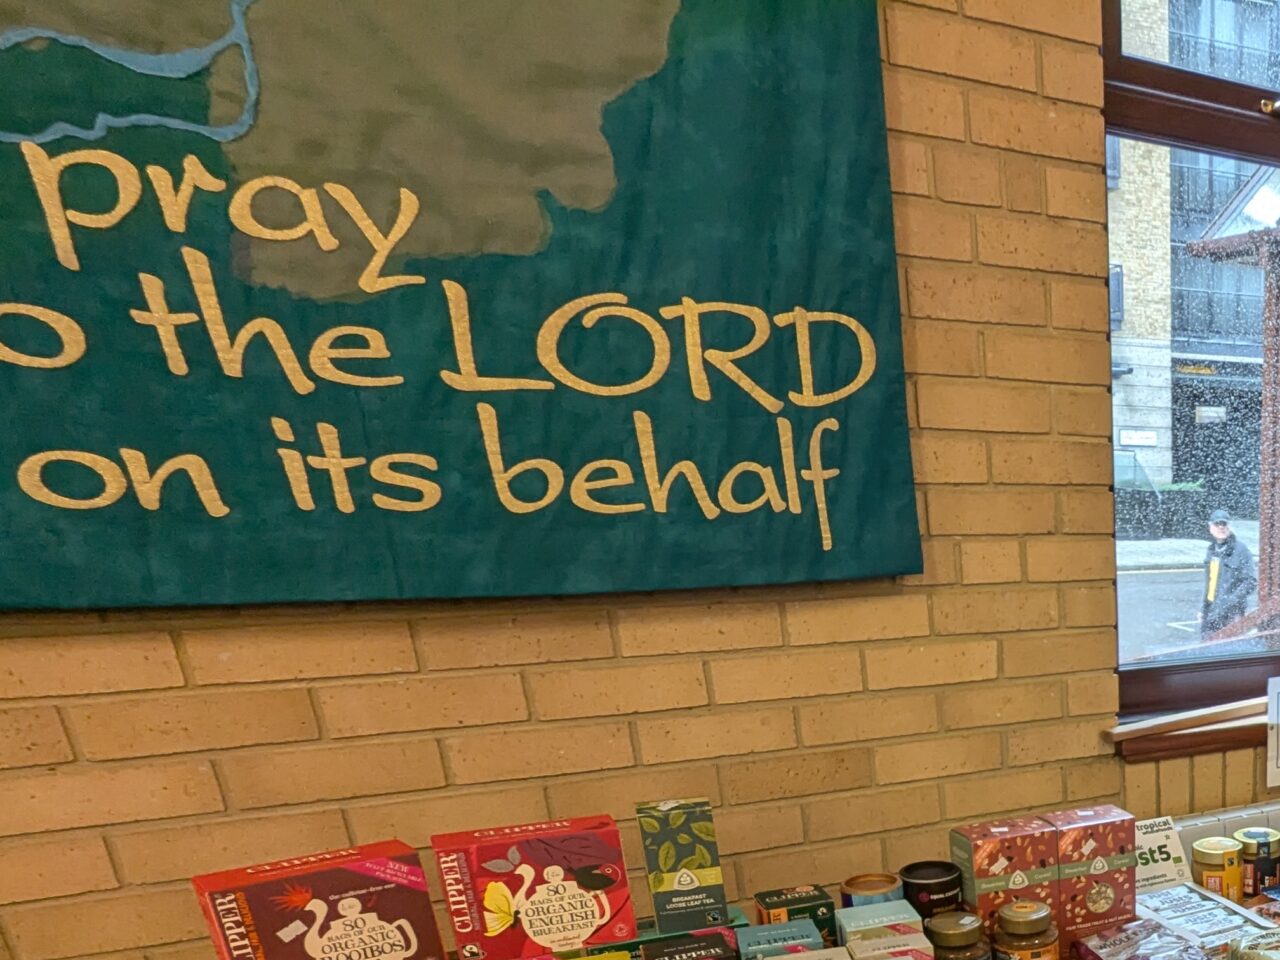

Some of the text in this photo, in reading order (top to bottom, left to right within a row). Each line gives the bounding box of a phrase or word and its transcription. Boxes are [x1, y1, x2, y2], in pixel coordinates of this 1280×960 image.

[21, 141, 426, 293] pray
[0, 246, 877, 412] o the LORD
[16, 403, 839, 552] on its behalf
[473, 819, 572, 838] CLIPPER
[1136, 819, 1172, 832] tropical
[246, 849, 361, 874] CLIPPER
[1136, 844, 1171, 866] st5
[440, 853, 473, 933] CLIPPER
[530, 898, 553, 907] BAGS
[567, 892, 586, 901] OUR
[672, 893, 708, 903] BREAKFAST
[525, 899, 595, 918] ORGANIC
[666, 902, 686, 910] LOOSE
[367, 925, 386, 933] OUR
[529, 910, 597, 929] ENGLISH
[532, 920, 596, 937] BREAKFAST
[321, 929, 397, 955] ORGANIC
